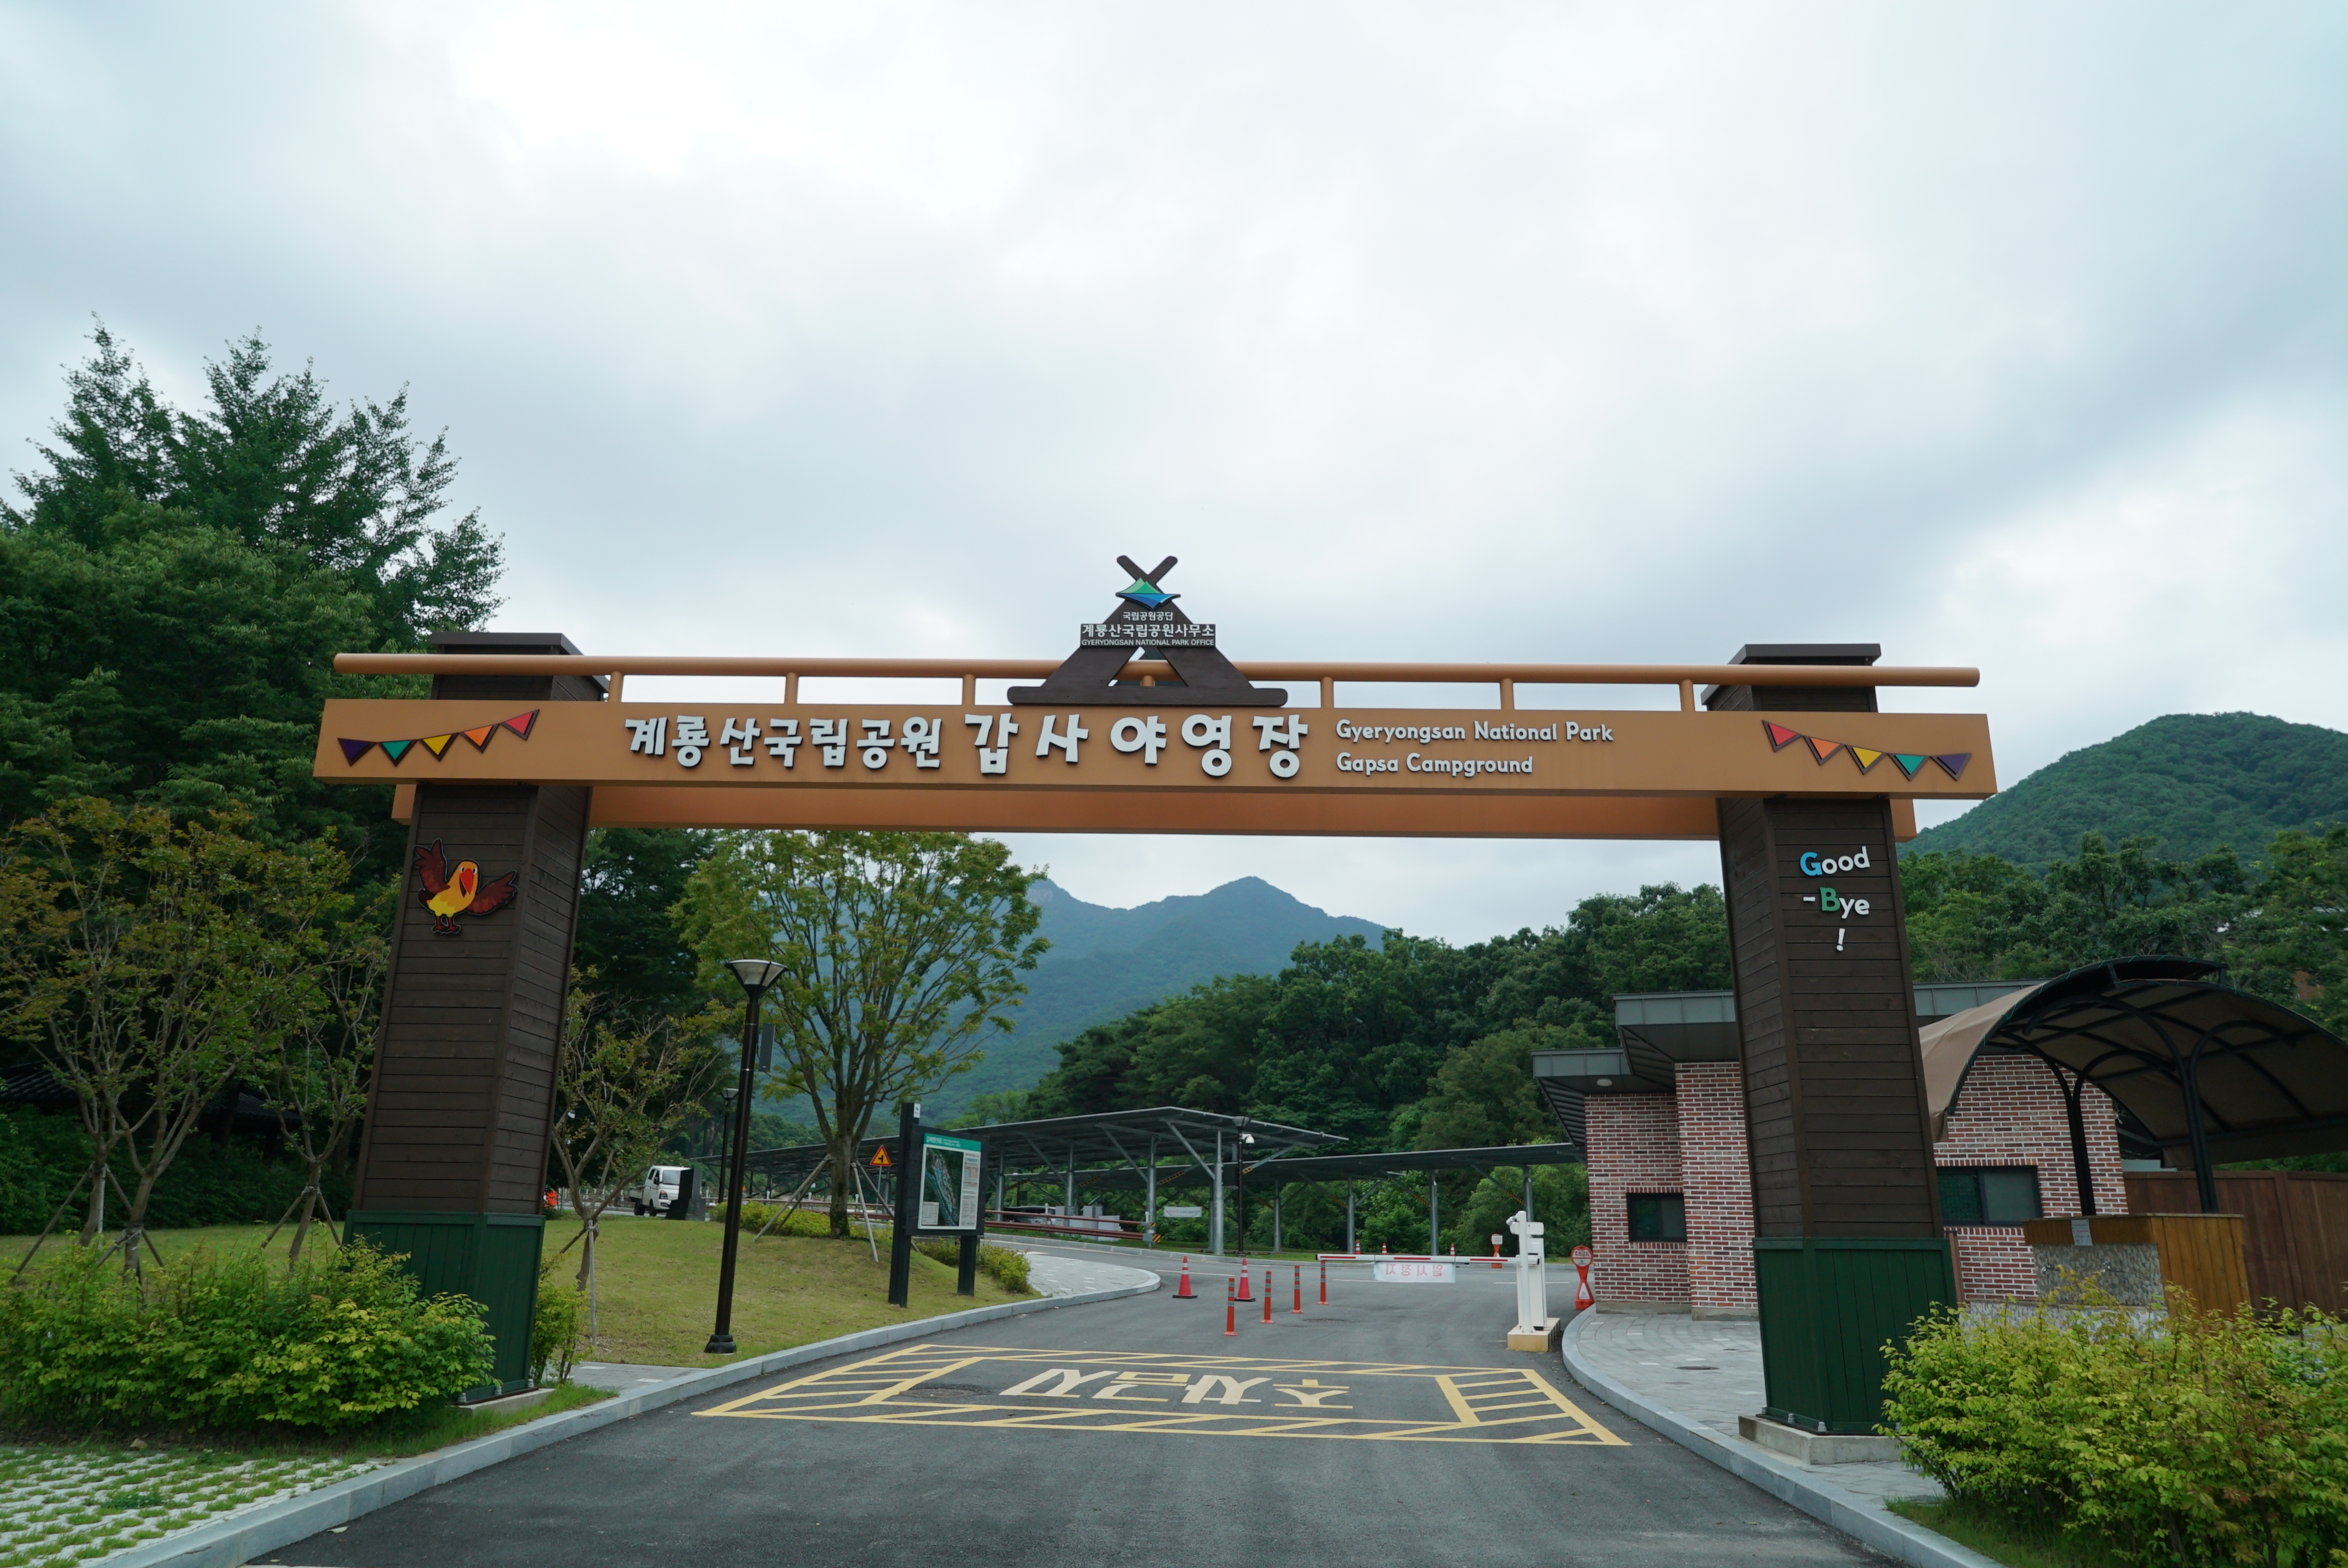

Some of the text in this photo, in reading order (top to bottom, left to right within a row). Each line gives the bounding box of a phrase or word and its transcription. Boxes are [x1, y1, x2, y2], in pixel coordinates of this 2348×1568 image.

[1122, 611, 1173, 621] 국립공원공단
[1082, 623, 1214, 638] 계룡산국립공원사무소
[625, 715, 942, 768] 계룡산국립공원
[1336, 719, 1614, 744] Gyeryongsan National Park
[1336, 752, 1533, 777] Gapsa Campground
[1800, 845, 1870, 876] Good
[999, 1369, 1353, 1409] 주차금지
